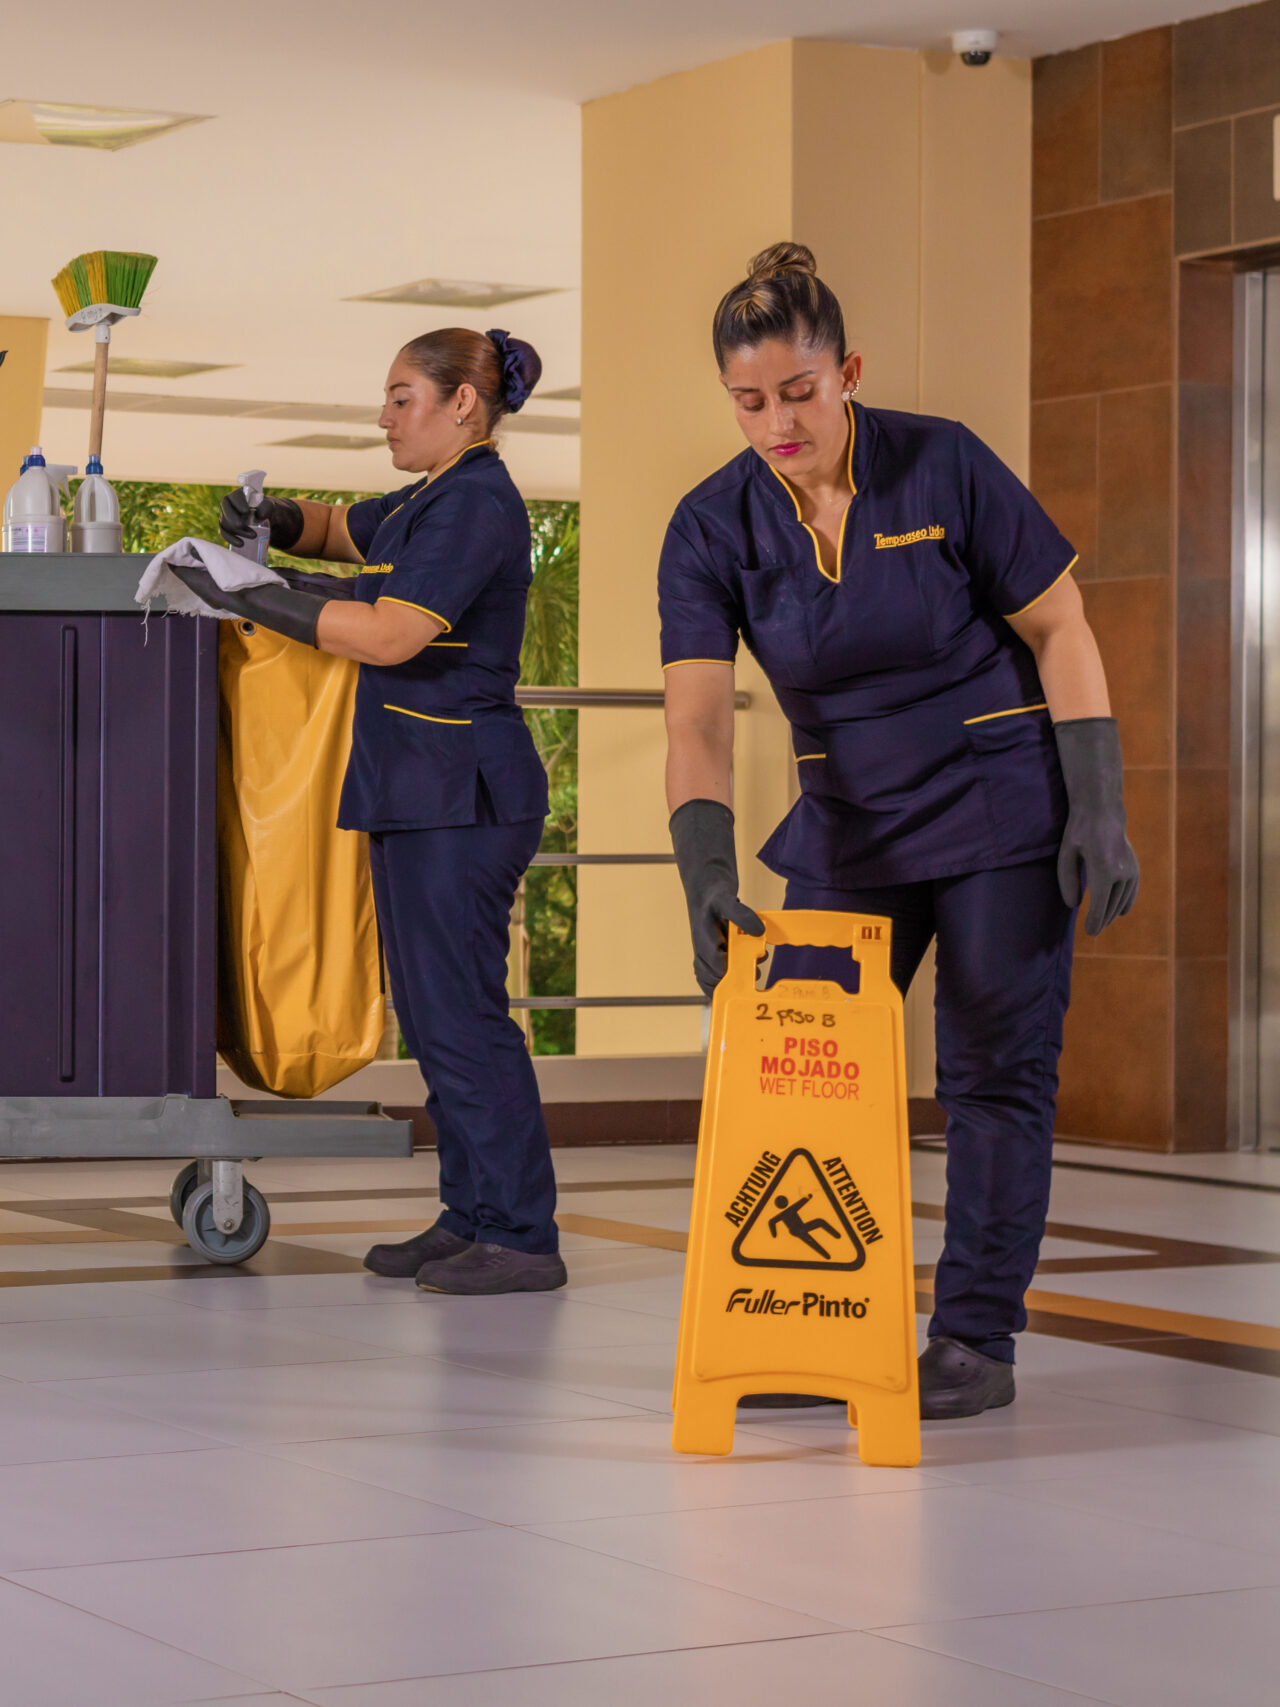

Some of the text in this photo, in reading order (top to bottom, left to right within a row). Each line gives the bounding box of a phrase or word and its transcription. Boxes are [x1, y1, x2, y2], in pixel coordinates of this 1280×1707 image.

[755, 1003, 773, 1020] 2
[822, 1013, 836, 1027] B
[784, 1037, 838, 1058] PISO
[761, 1056, 860, 1080] MOJADO
[760, 1076, 860, 1100] WET FLOOR
[724, 1150, 782, 1228] ACHTUNG
[822, 1156, 884, 1246] ATTENTION
